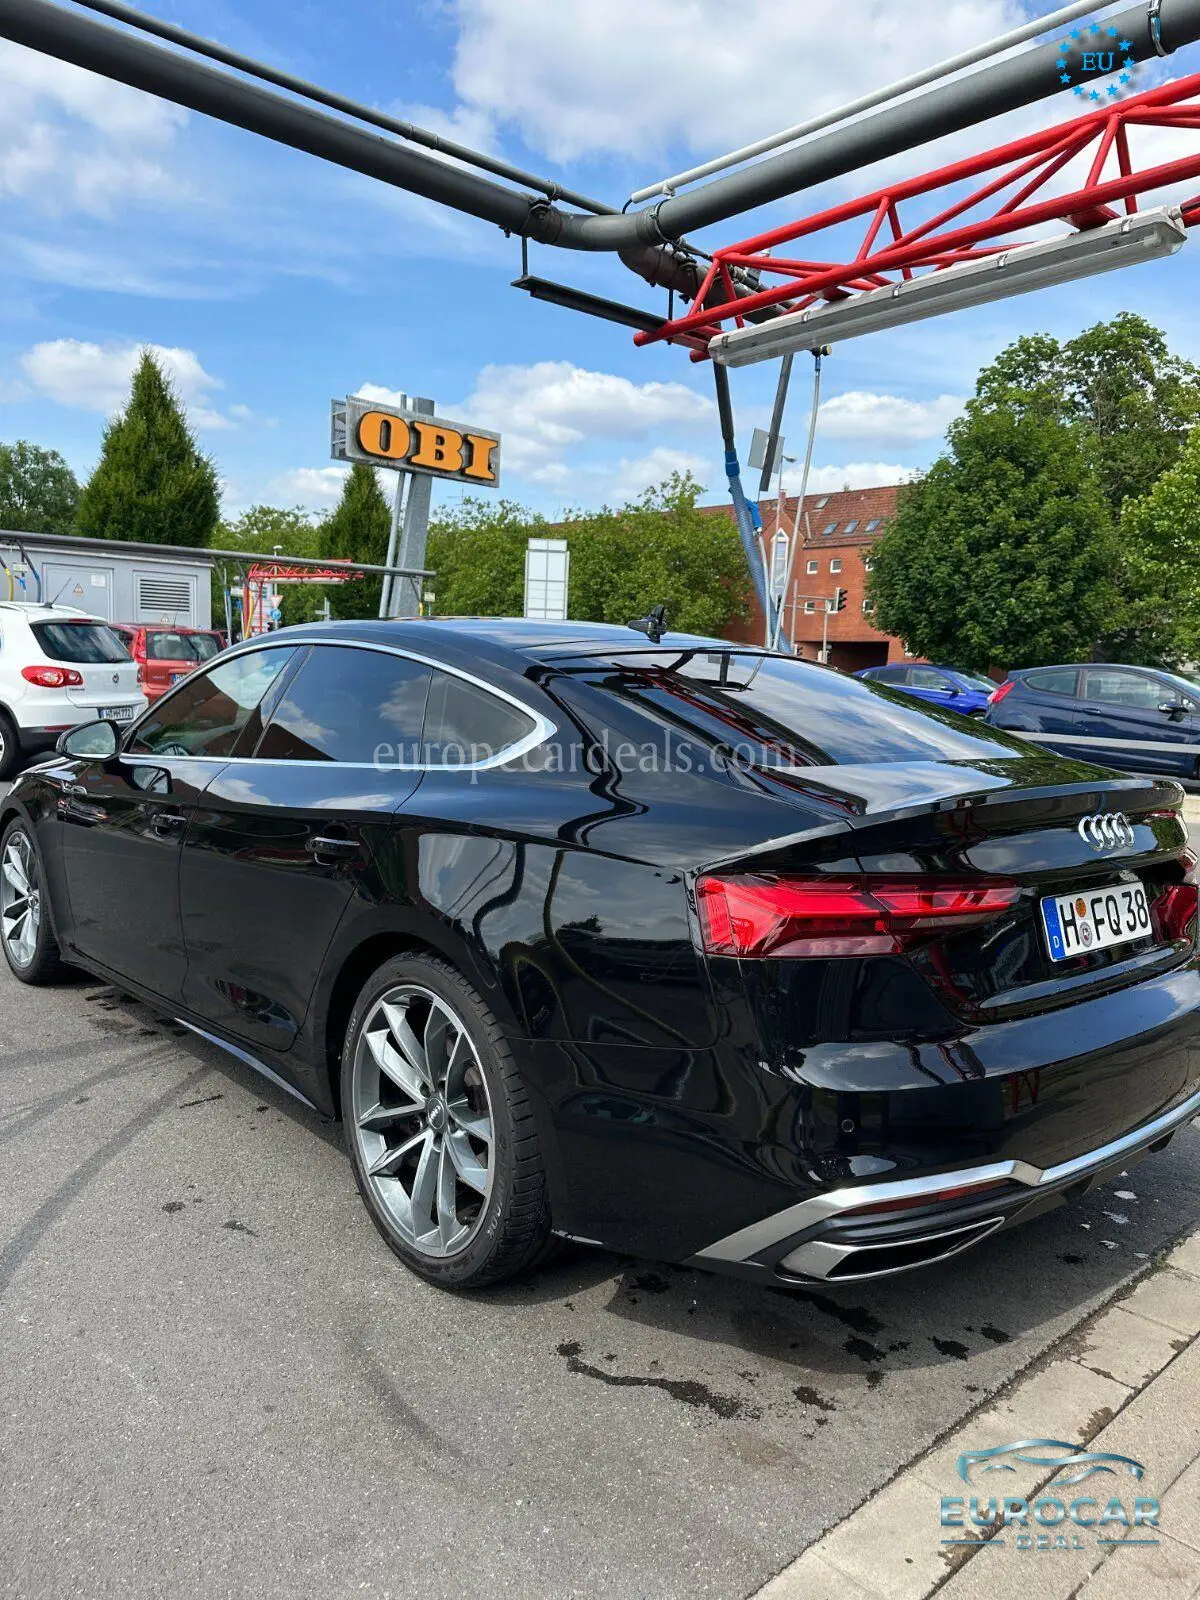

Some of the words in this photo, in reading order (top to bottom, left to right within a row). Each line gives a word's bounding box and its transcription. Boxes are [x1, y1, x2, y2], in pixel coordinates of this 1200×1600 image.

[357, 410, 498, 480] OBI
[1060, 902, 1080, 948] H
[1121, 889, 1148, 932] 38
